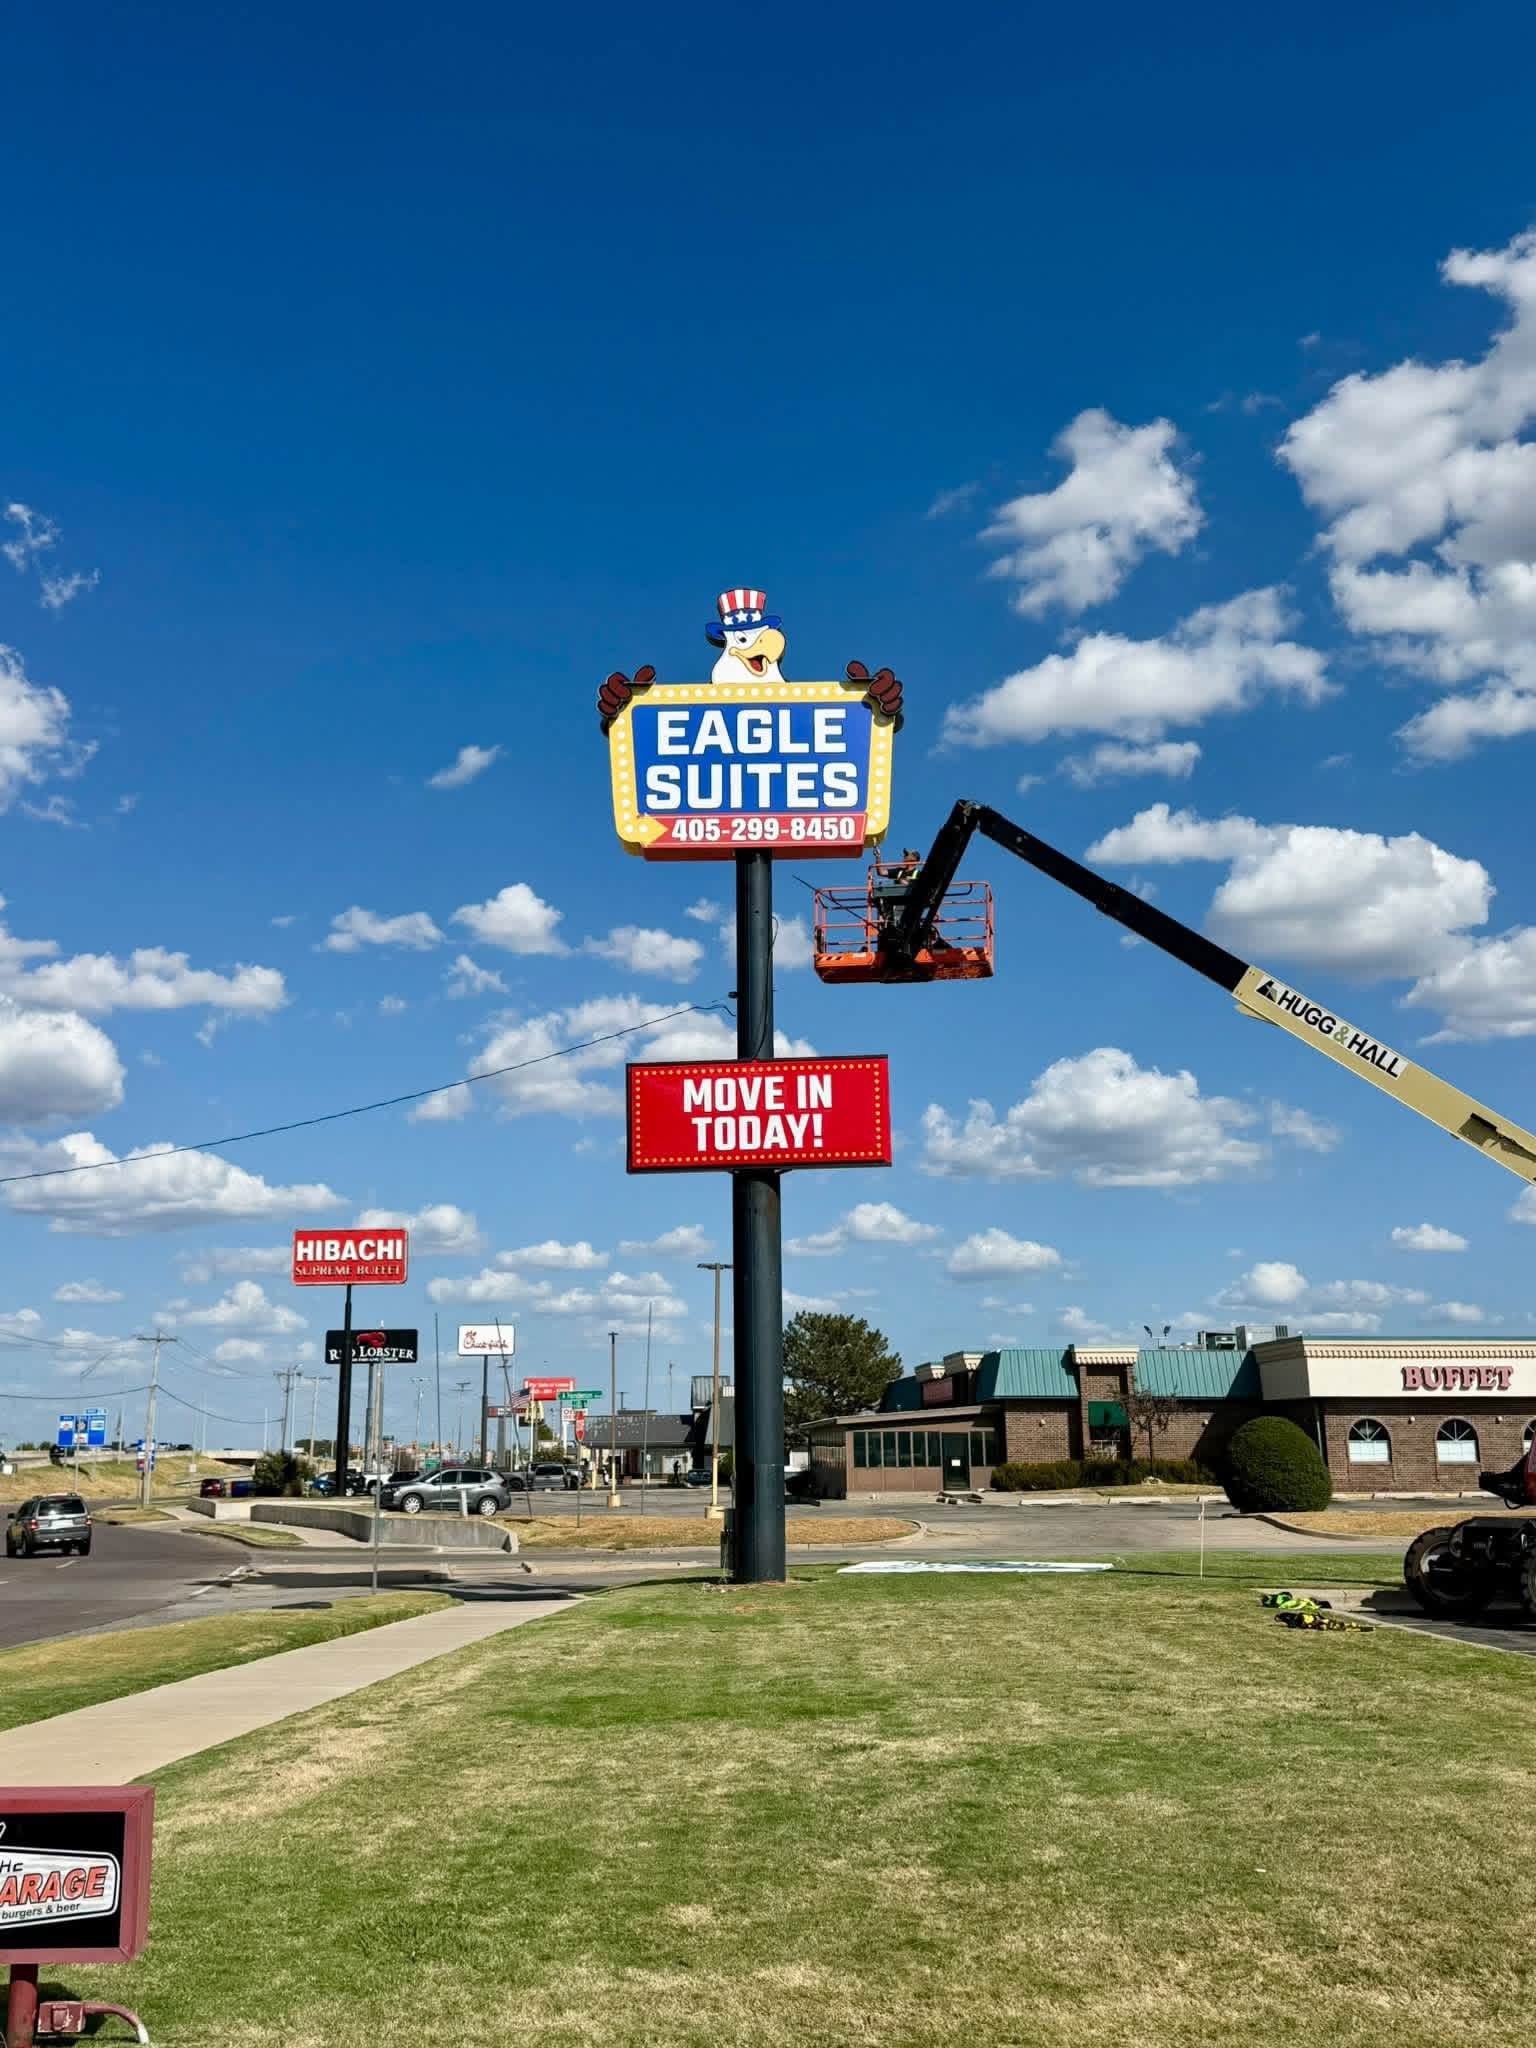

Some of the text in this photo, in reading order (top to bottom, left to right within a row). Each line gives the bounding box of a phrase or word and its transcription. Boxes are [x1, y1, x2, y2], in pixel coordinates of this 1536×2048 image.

[657, 708, 847, 755] EAGLE
[645, 762, 858, 810] SUITES
[671, 817, 856, 841] 405-299-8450
[1277, 990, 1400, 1078] HUGG & HALL
[683, 1074, 832, 1113] MOVE IN
[691, 1114, 823, 1152] TODAY!
[296, 1239, 403, 1261] HIBACHI
[295, 1264, 400, 1276] SUPREME BUFFET
[359, 1346, 415, 1360] LOBSTER
[1403, 1366, 1514, 1390] BUFFET
[0, 1865, 109, 1907] ARAGE
[2, 1903, 81, 1920] burgers & beer
